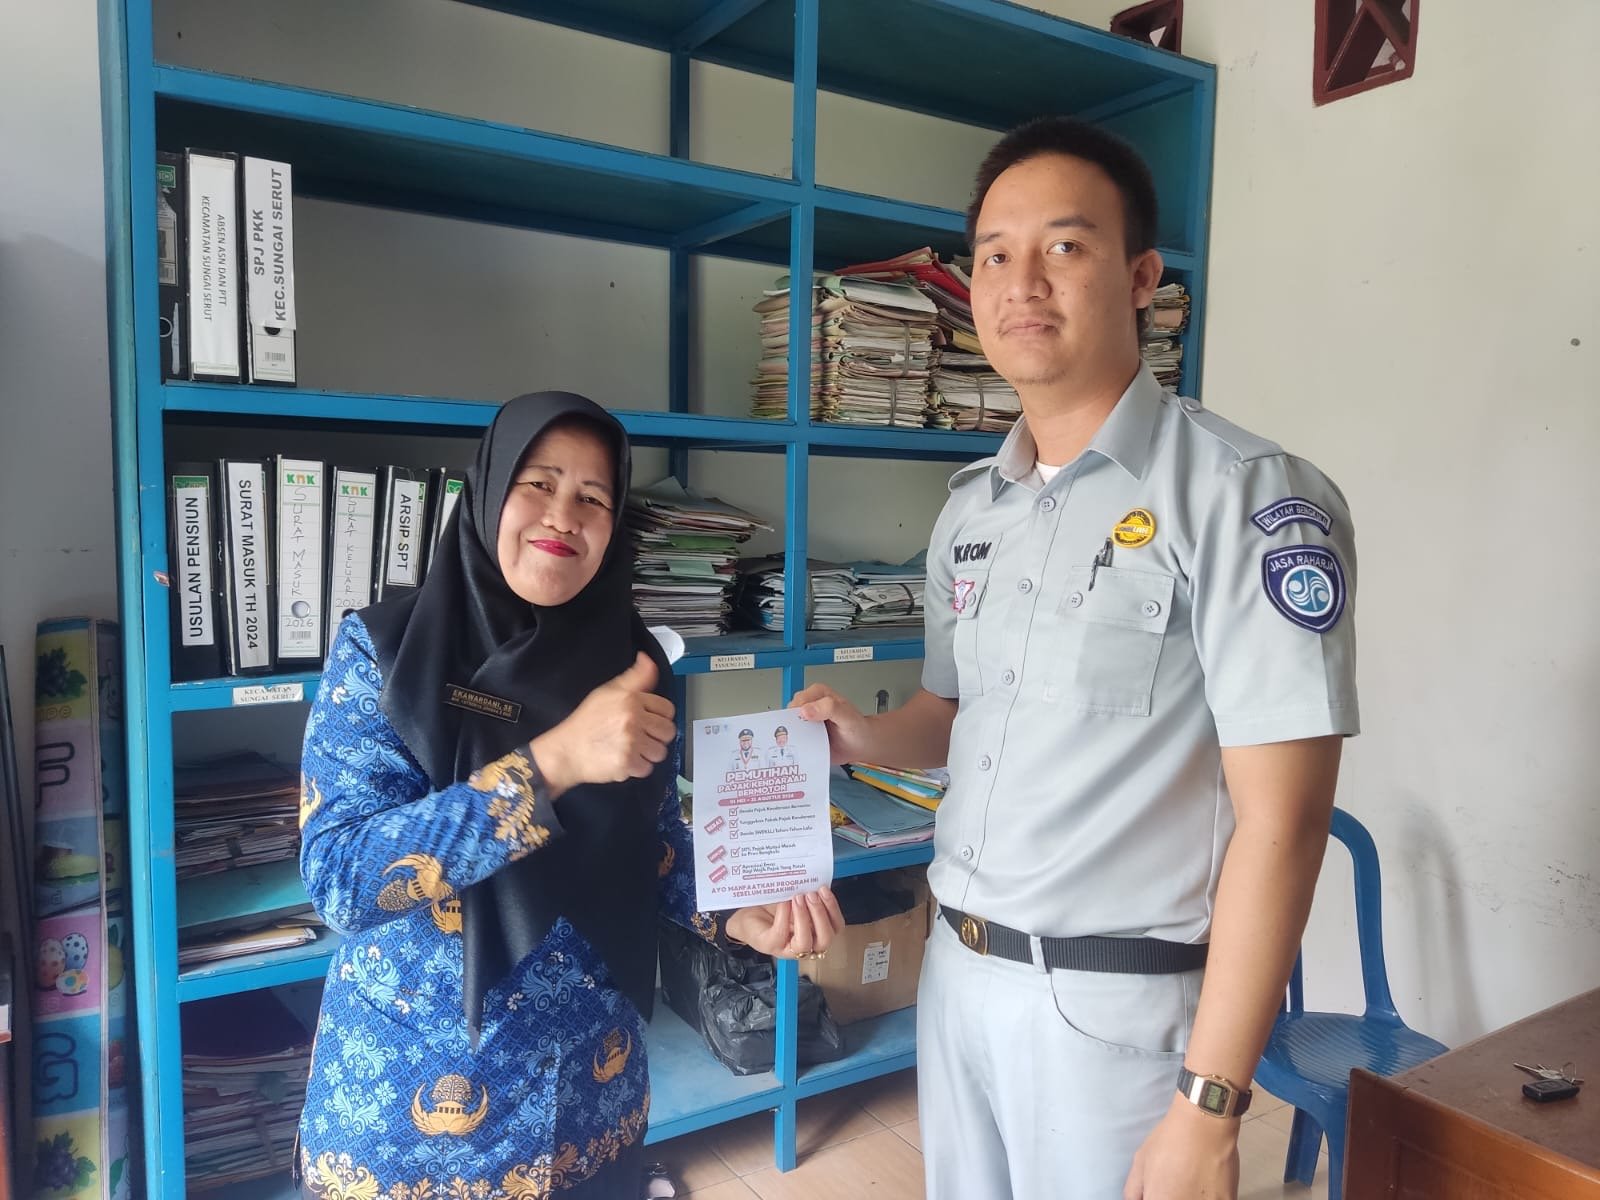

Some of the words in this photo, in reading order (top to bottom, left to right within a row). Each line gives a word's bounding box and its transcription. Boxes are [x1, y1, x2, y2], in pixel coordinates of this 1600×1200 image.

[271, 168, 284, 221] SERUT
[201, 195, 211, 254] KECAMATAN
[217, 214, 226, 245] ABSEN
[252, 209, 264, 242] PKK
[217, 246, 227, 265] ASN
[254, 247, 265, 276] SPJ
[202, 255, 212, 291] SUNGAI
[218, 267, 227, 287] DAN
[203, 293, 212, 322] SERUT
[218, 289, 227, 306] PTT
[239, 479, 254, 530] SURAT
[398, 494, 412, 540] ARSIP
[1261, 505, 1294, 527] WILAYAH
[185, 497, 201, 567] PENSIUN
[242, 535, 256, 588] MASUK
[397, 541, 409, 572] SPT
[1270, 556, 1295, 573] JASA
[1296, 555, 1335, 573] RAHARJA
[188, 572, 203, 638] USULAN
[245, 592, 257, 612] TH
[246, 617, 258, 650] 2024
[285, 617, 314, 628] 2026
[717, 781, 752, 793] PAJAK
[751, 774, 806, 788] KENDARAAN
[726, 765, 799, 783] PEMUTIHAN
[738, 784, 787, 797] BERMOTOR
[728, 883, 775, 892] MANFAATKAN
[776, 878, 810, 887] PROGRAM
[732, 889, 763, 898] SEBELUM
